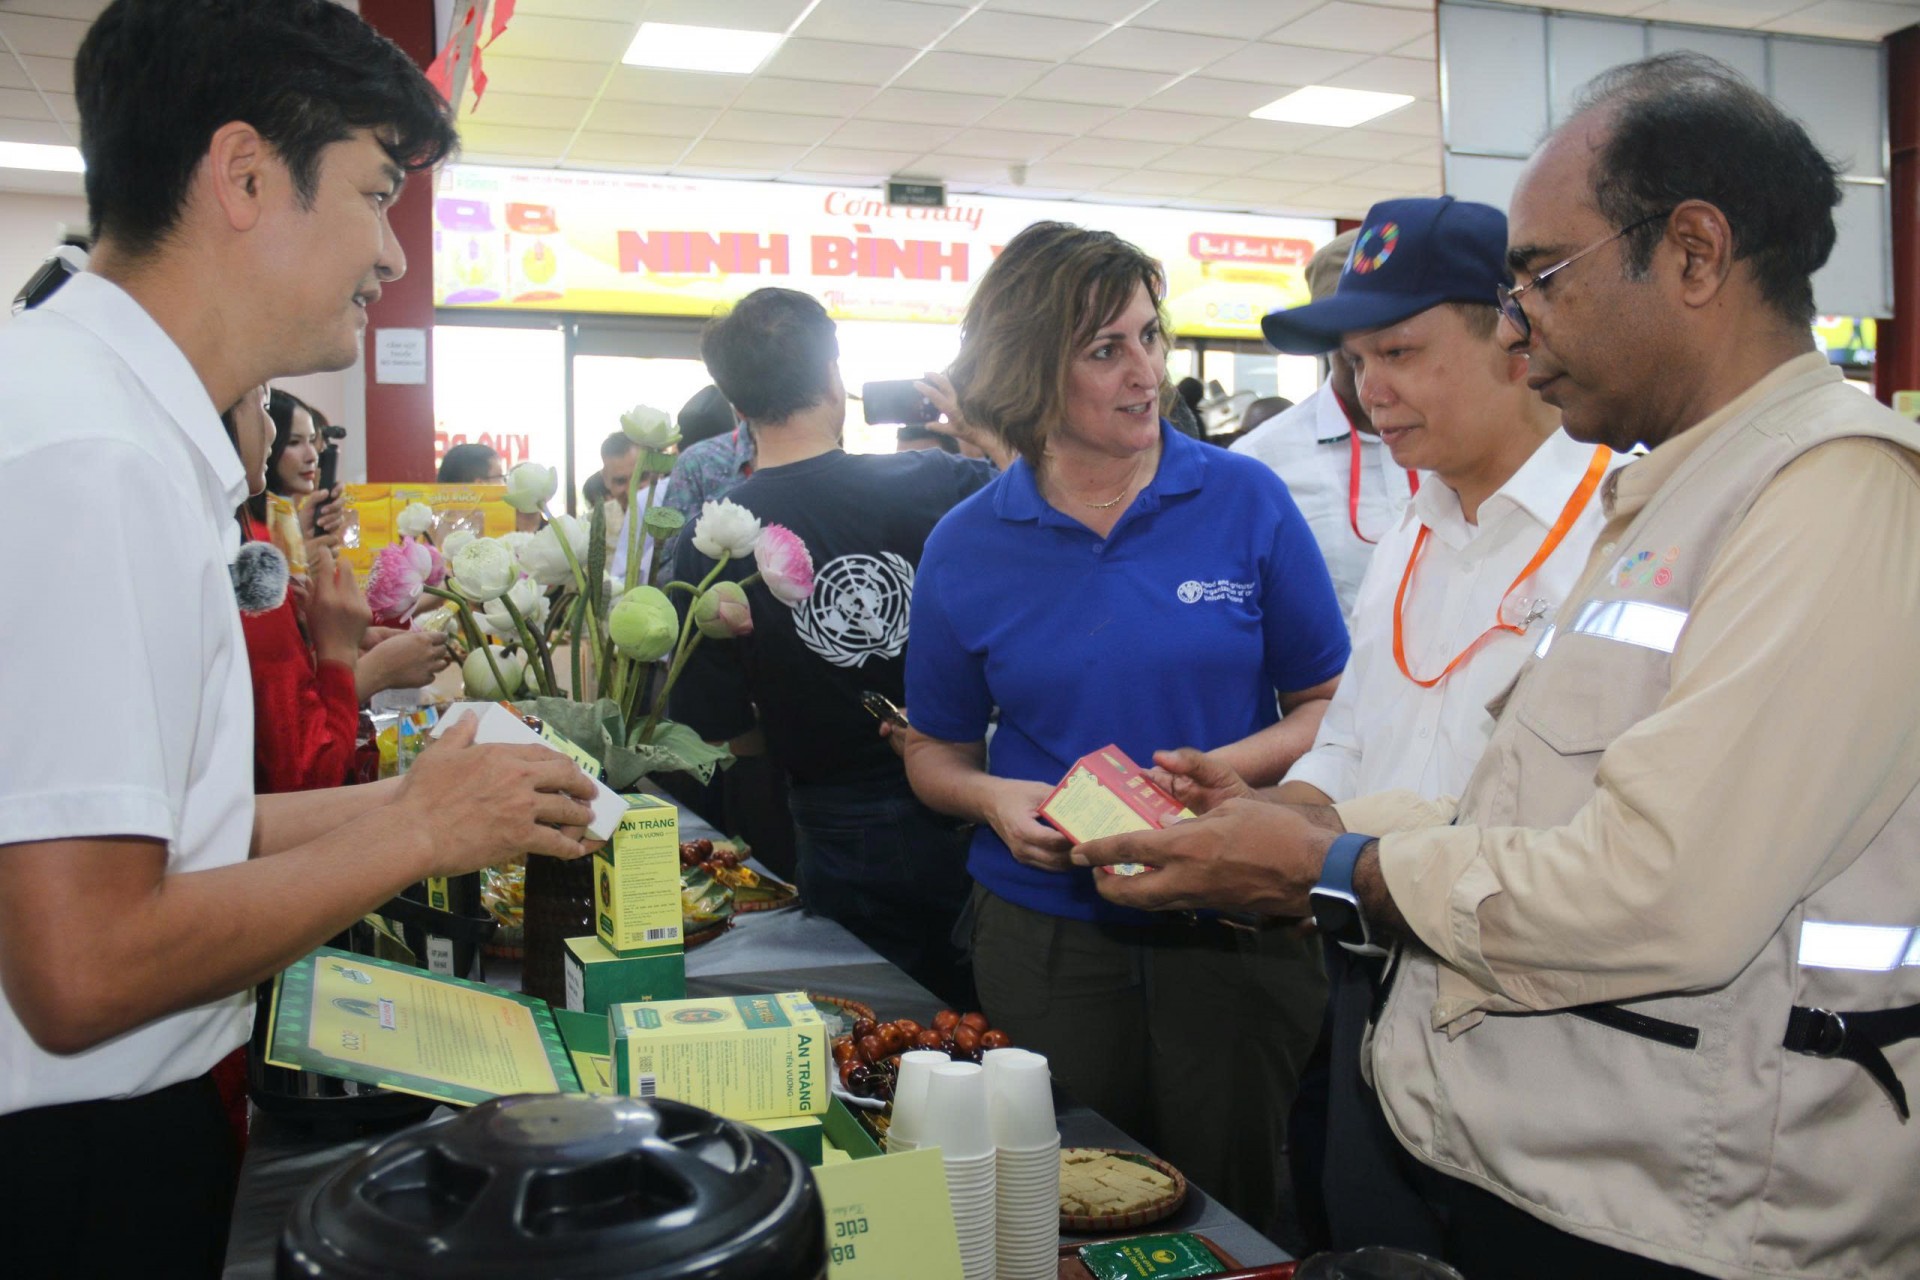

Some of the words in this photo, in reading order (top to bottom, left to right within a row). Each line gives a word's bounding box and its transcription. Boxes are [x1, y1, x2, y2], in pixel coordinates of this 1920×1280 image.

[824, 191, 893, 217] Cơm
[617, 230, 790, 275] NINH
[811, 223, 969, 282] BÌNH
[619, 819, 636, 832] AN
[797, 1033, 812, 1058] AN
[798, 1061, 814, 1111] TRÀNG
[835, 1217, 869, 1240] CÚC
